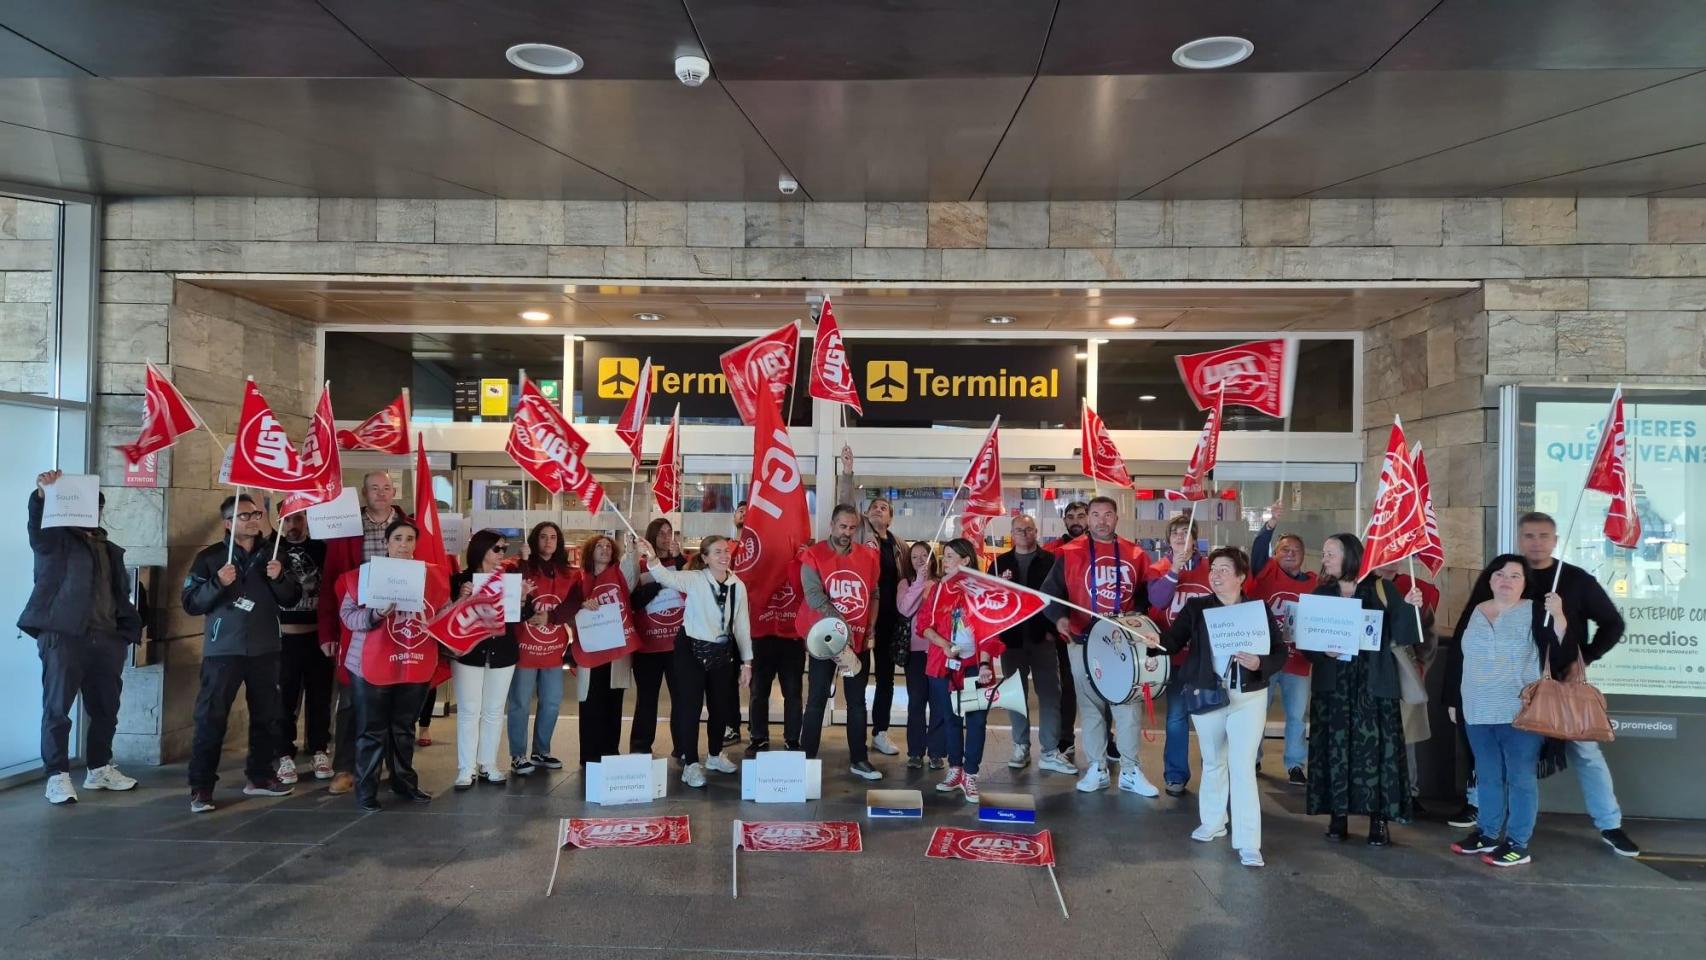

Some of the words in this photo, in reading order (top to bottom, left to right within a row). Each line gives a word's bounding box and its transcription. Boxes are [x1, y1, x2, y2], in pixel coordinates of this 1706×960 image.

[913, 367, 1059, 397] Terminal
[1094, 565, 1132, 586] UGT
[829, 577, 863, 600] UGT
[1215, 640, 1253, 649] esperando
[1621, 721, 1673, 731] promedios
